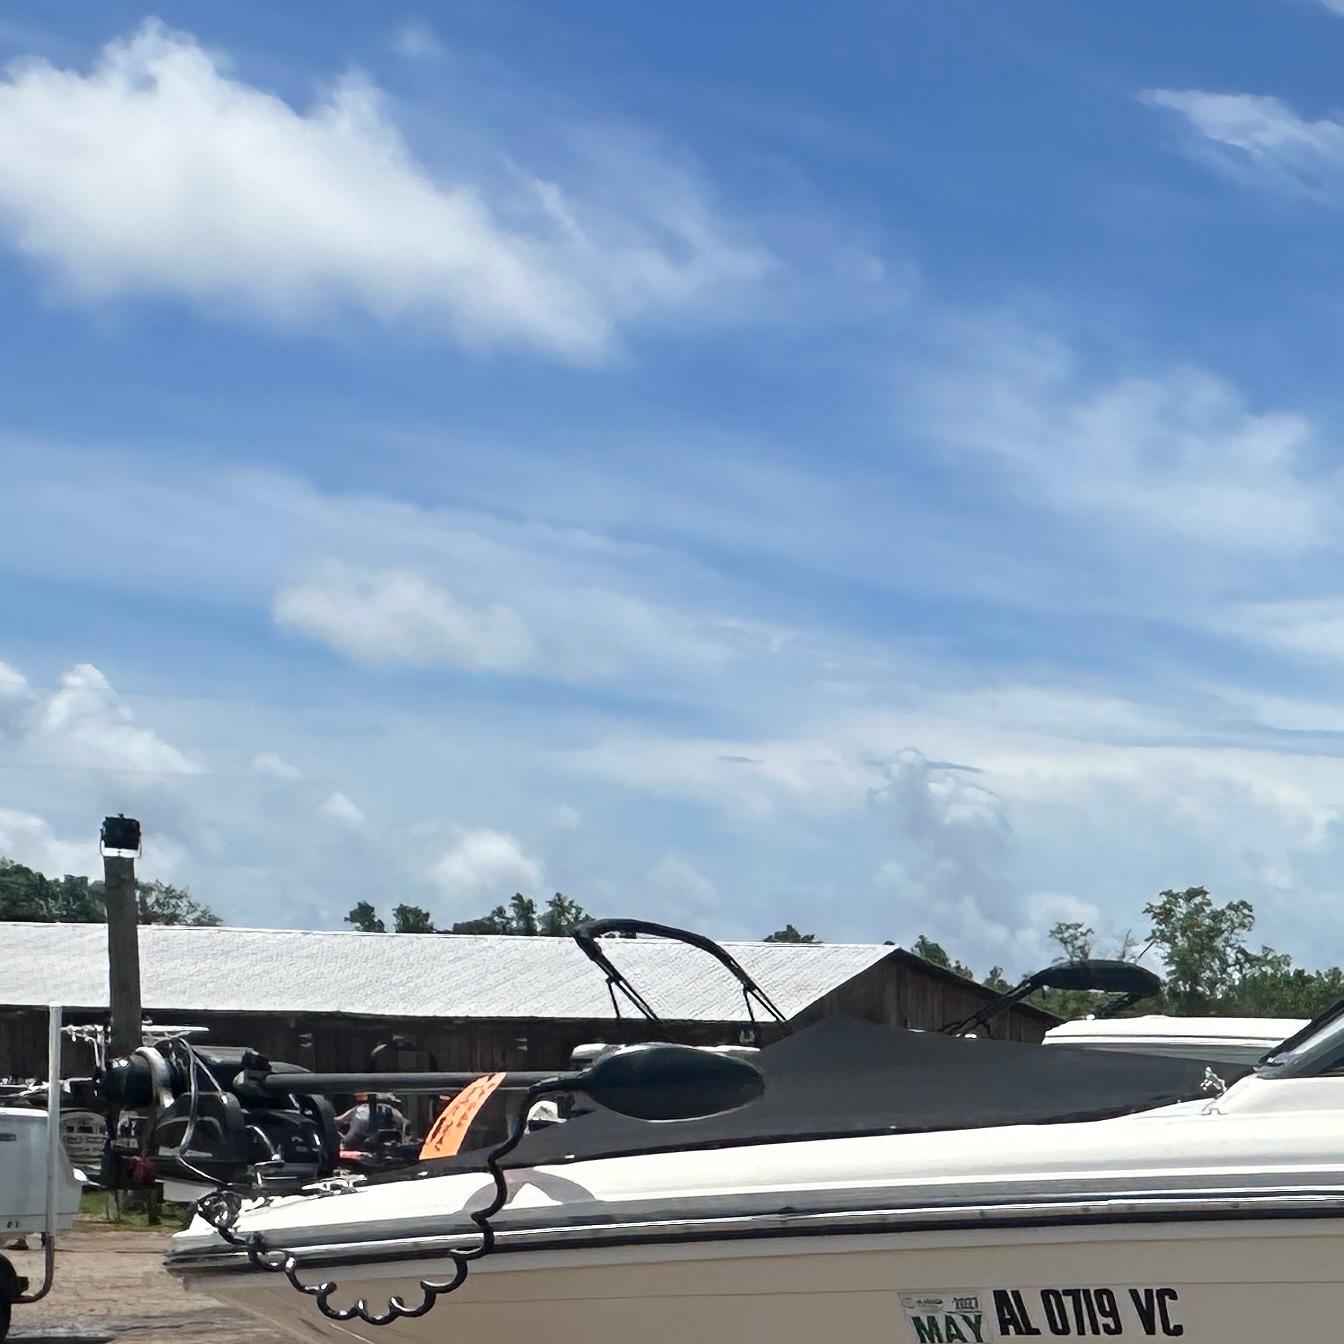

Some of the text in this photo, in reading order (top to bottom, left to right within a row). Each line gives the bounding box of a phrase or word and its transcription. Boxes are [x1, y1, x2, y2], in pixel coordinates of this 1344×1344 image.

[911, 1313, 984, 1344] MAY
[992, 1288, 1184, 1337] AL 0719 VC
